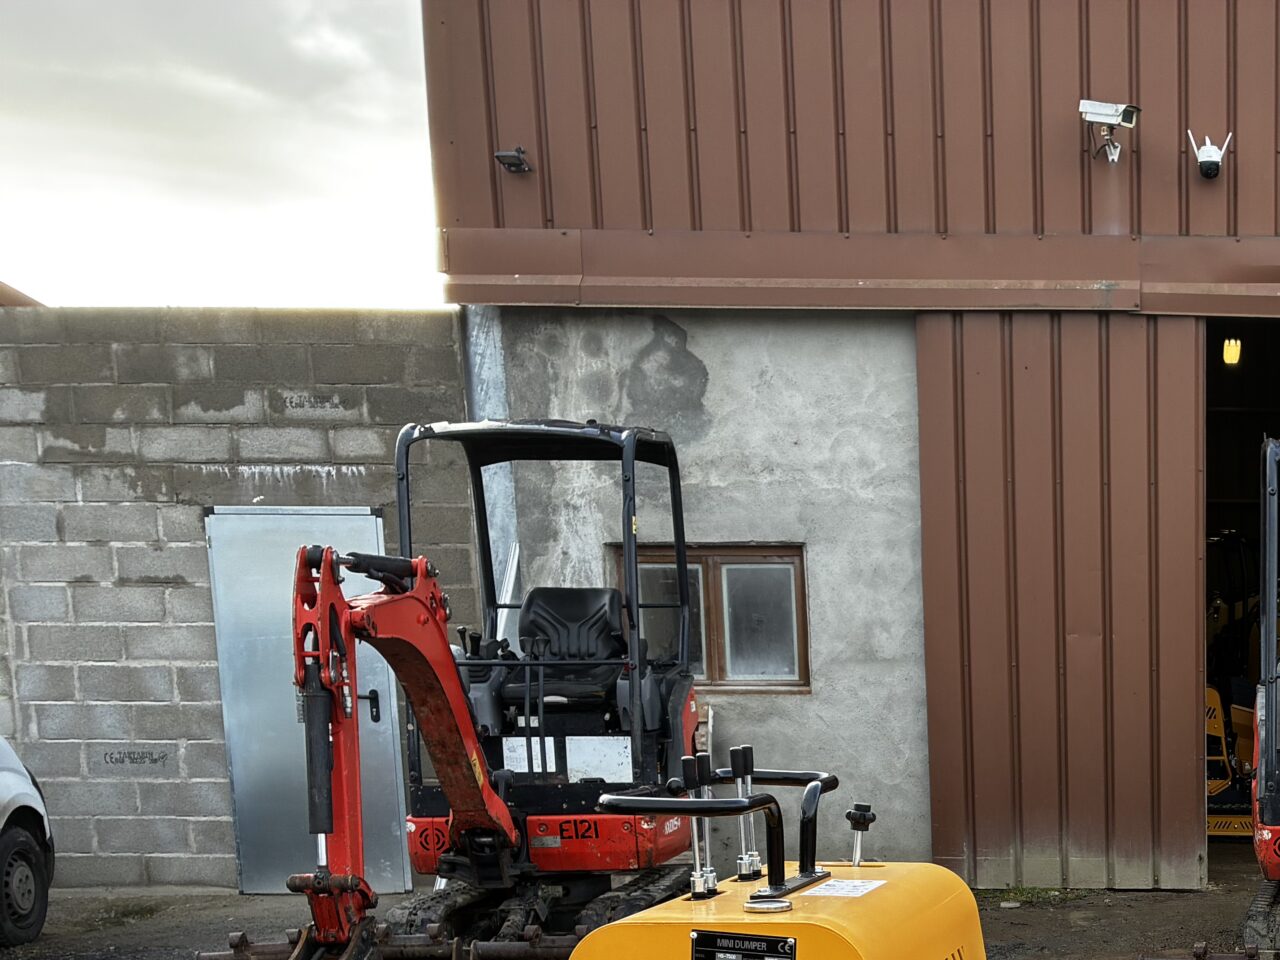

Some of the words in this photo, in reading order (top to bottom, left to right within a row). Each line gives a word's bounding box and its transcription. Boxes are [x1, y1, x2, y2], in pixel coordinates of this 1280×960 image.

[559, 819, 599, 840] E121
[717, 938, 734, 948] MINI
[735, 940, 767, 951] DUMPER
